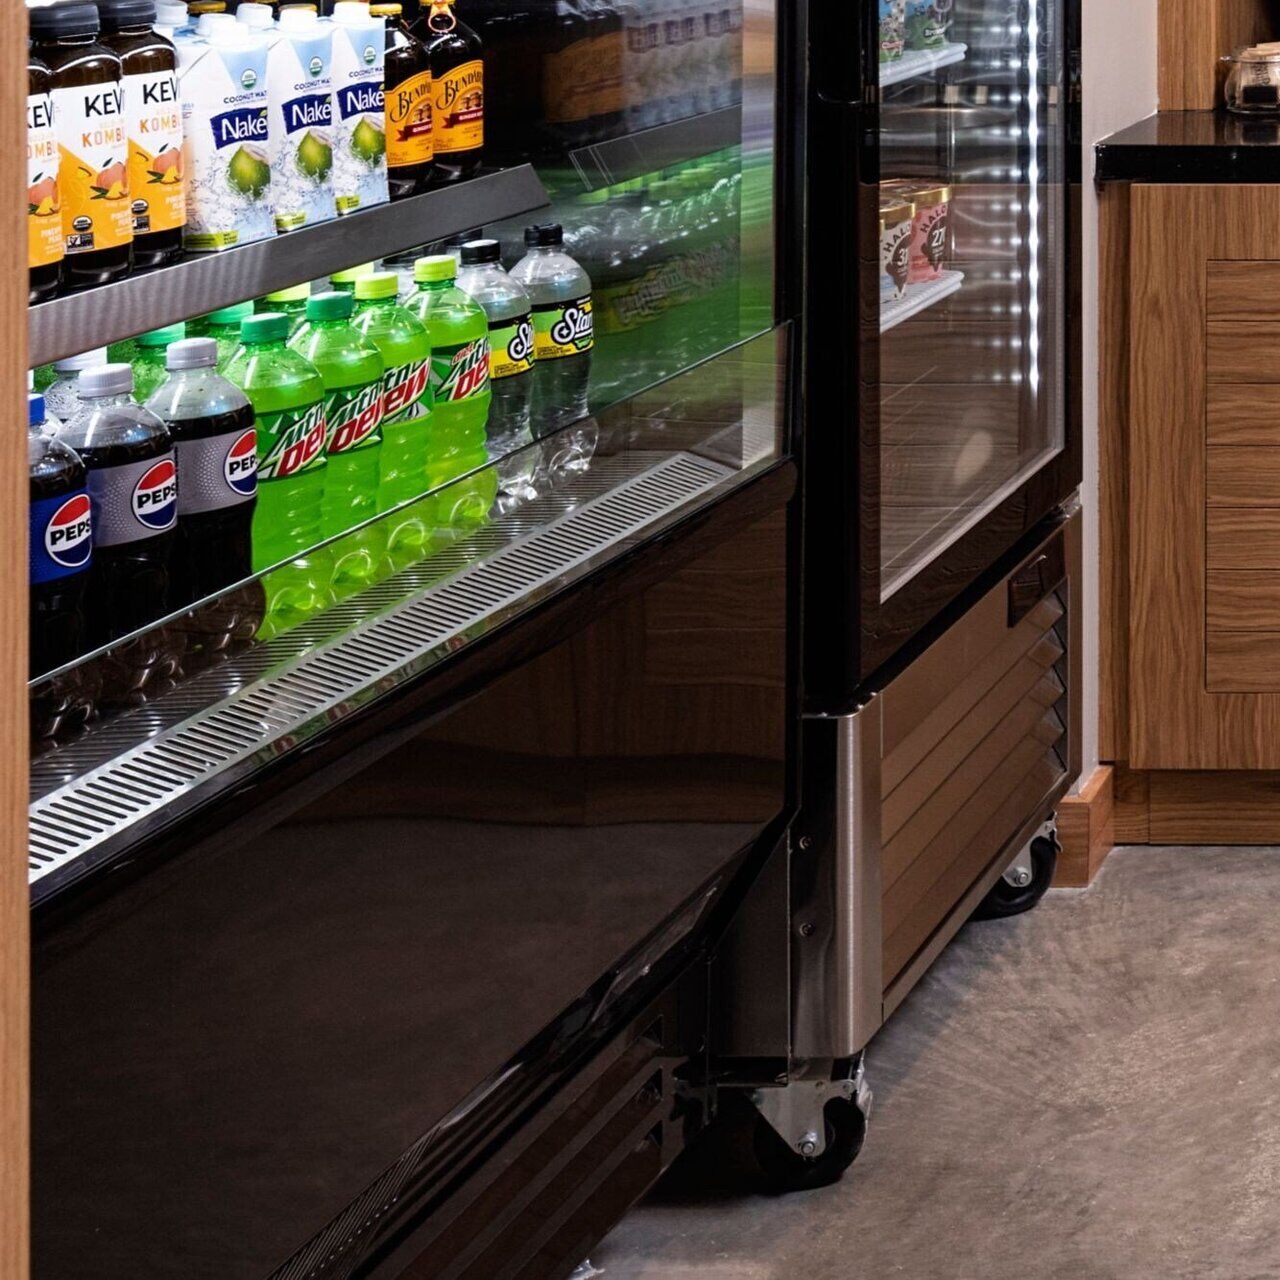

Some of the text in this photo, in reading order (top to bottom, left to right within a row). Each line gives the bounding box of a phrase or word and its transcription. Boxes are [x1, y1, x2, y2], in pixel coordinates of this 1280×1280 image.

[349, 67, 376, 79] COCONUT
[294, 79, 320, 91] COCONUT
[223, 91, 254, 104] COCONUT
[347, 89, 385, 113] Nake
